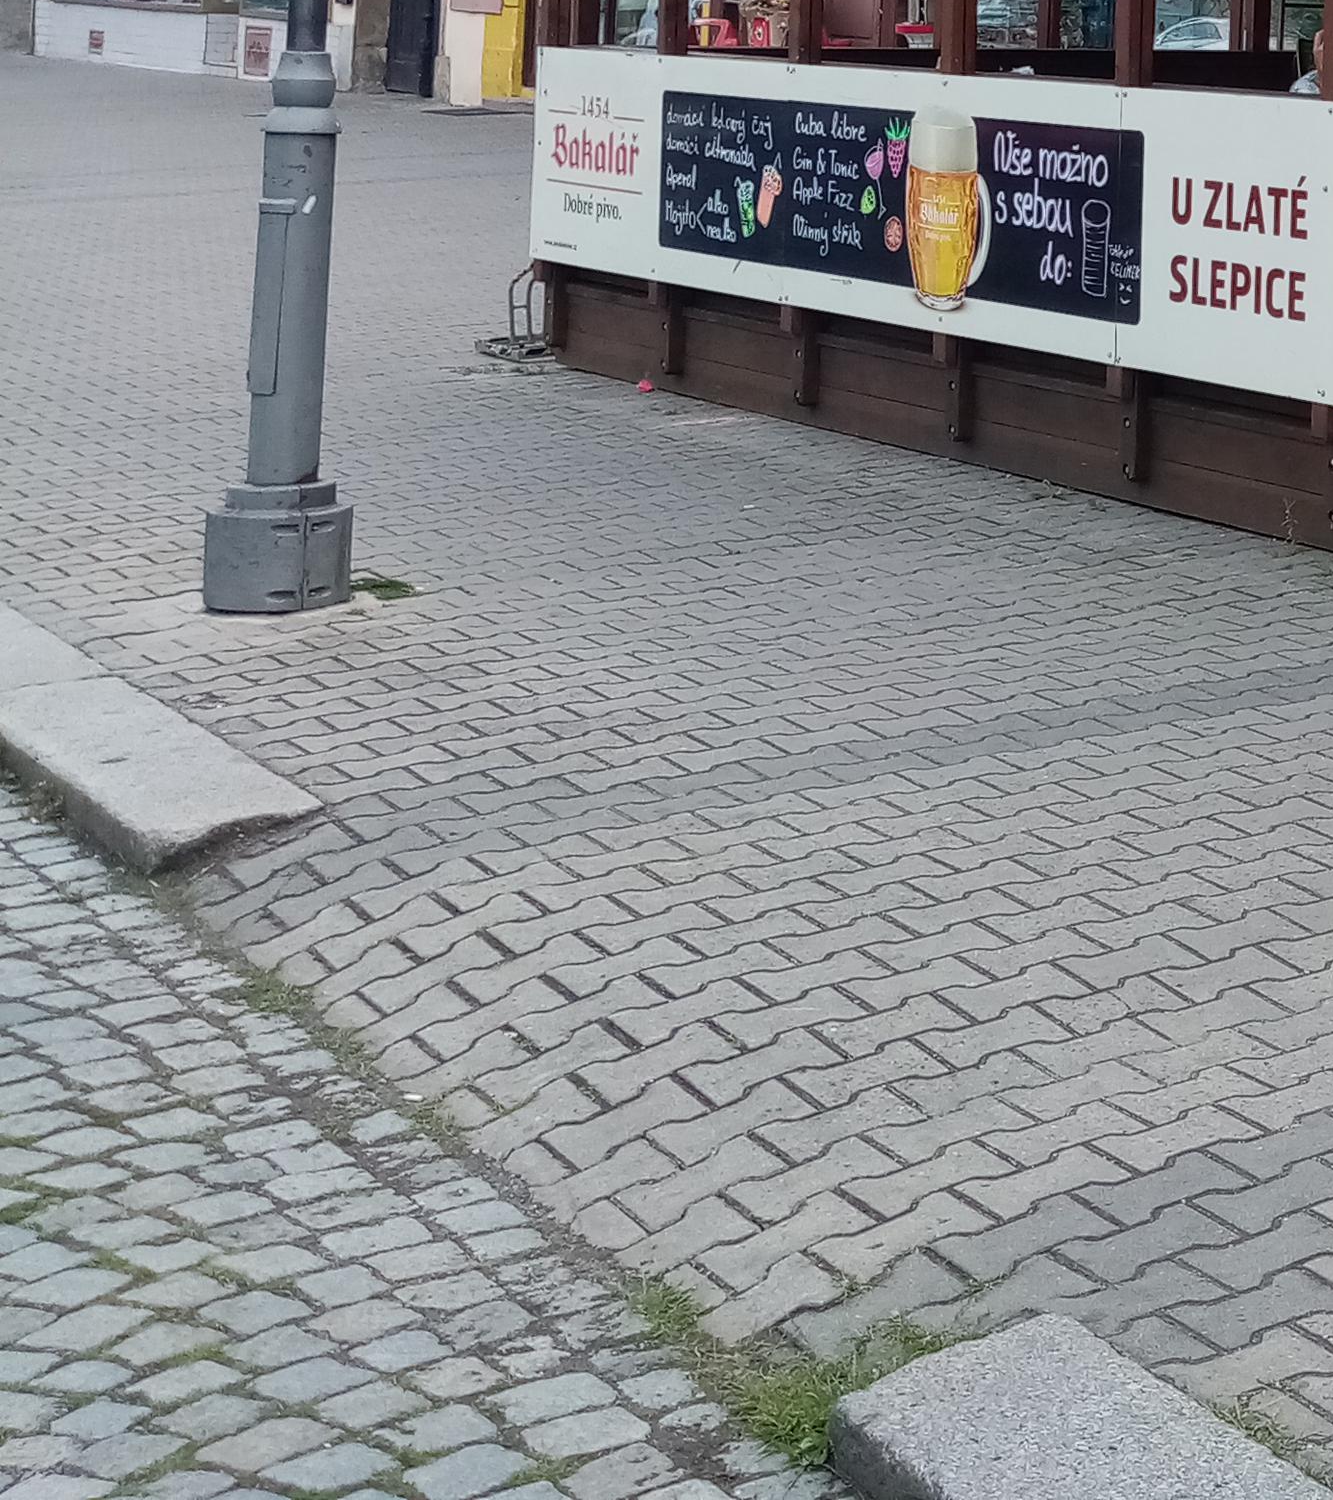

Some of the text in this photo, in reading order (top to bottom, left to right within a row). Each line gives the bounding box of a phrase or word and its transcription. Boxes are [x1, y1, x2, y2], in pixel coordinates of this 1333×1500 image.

[581, 95, 610, 119] 1454
[795, 111, 867, 142] Cuba libre
[551, 123, 640, 176] Bakalář
[793, 146, 860, 180] Gin & Tonic
[1039, 144, 1108, 188] možno
[666, 163, 697, 190] Aperol
[793, 176, 823, 205] Apple
[563, 192, 622, 223] Dobré pivo.
[665, 199, 697, 235] Mojito
[1012, 177, 1074, 238] sebou
[1172, 175, 1308, 240] U ZLATÉ
[1040, 241, 1072, 285] do:
[1169, 254, 1306, 322] SLEPICE
